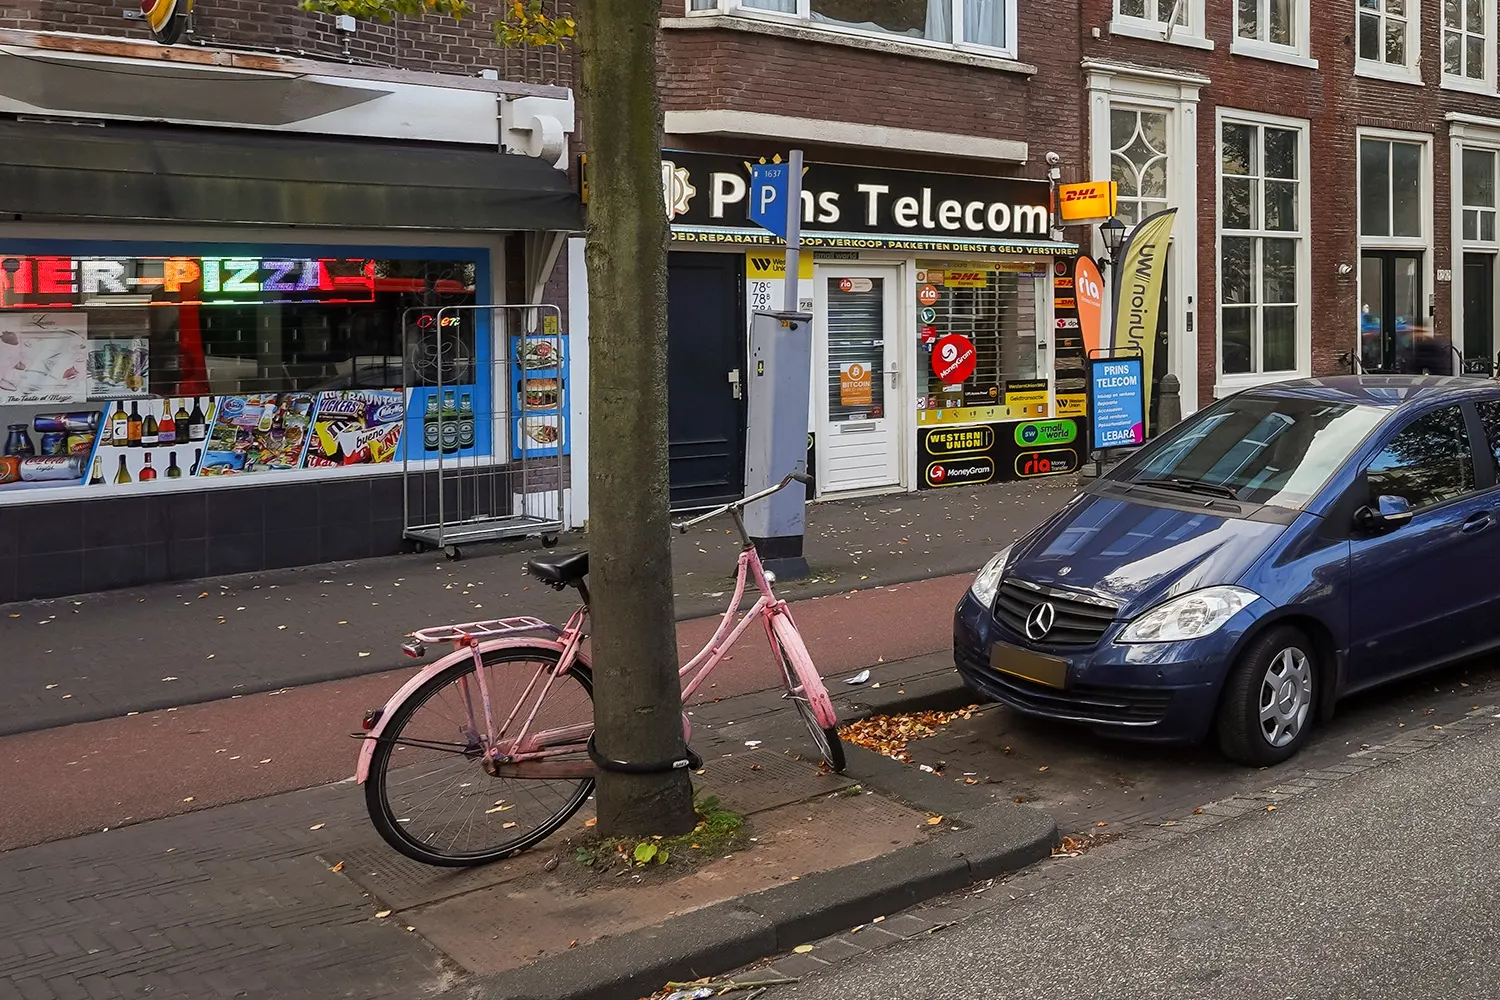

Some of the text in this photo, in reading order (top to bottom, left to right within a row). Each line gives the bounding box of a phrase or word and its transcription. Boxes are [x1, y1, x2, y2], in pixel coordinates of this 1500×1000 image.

[765, 170, 781, 178] 1637
[760, 185, 776, 215] P
[1065, 188, 1099, 202] DHL
[710, 172, 1047, 234] Pns Telecom
[888, 241, 950, 251] PAKKETTEN
[952, 244, 987, 252] DIENST
[989, 245, 997, 253] &
[998, 246, 1024, 254] GELD
[1025, 247, 1079, 255] VERSTUREN
[950, 272, 981, 281] DHL
[840, 279, 851, 287] ria
[1078, 270, 1100, 300] ria
[920, 287, 936, 298] ria
[417, 315, 461, 328] Oen
[940, 349, 973, 379] MoneyGram
[1104, 364, 1129, 376] PRINS
[1096, 376, 1137, 388] TELECOM
[1039, 423, 1063, 433] small
[1046, 429, 1069, 439] world
[356, 429, 384, 449] bueno
[930, 431, 981, 443] WESTERN
[1101, 428, 1136, 442] LEBARA
[945, 439, 981, 450] UNION
[1024, 453, 1051, 474] ria
[947, 465, 990, 477] MoneyGram
